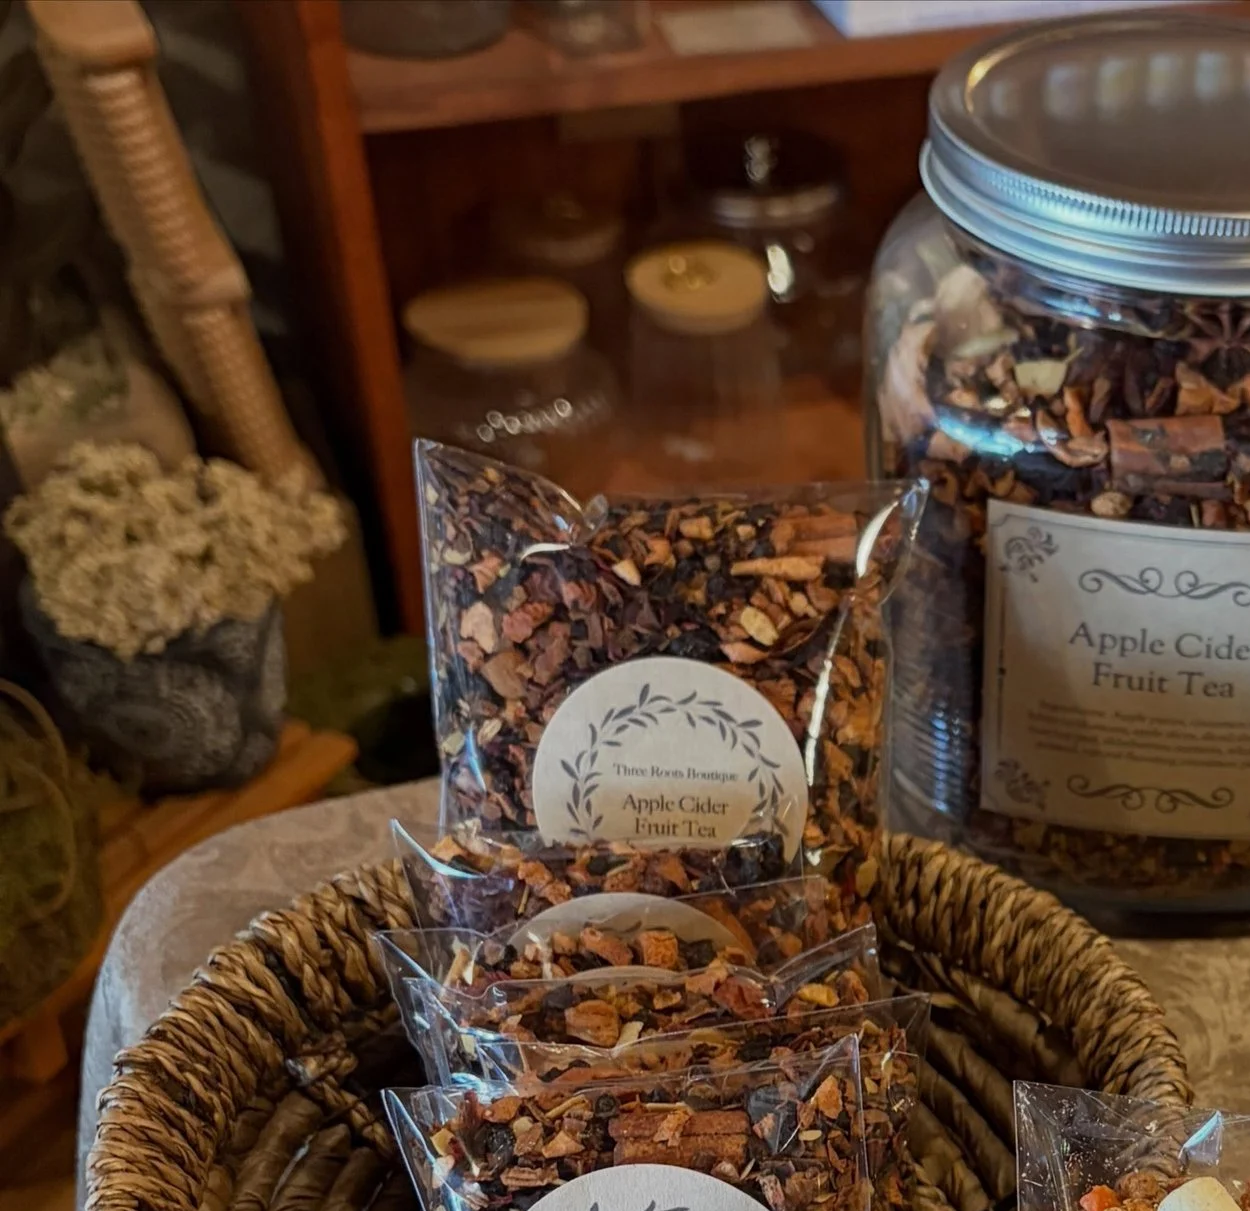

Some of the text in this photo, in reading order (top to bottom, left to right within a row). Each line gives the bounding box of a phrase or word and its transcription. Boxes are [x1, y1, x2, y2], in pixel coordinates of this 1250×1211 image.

[1068, 621, 1165, 657] Apple
[1092, 661, 1236, 698] Fruit Tea
[613, 762, 739, 783] Three Roots Boutique
[622, 793, 729, 816] Apple Cider
[634, 817, 717, 839] Fruit Tea
